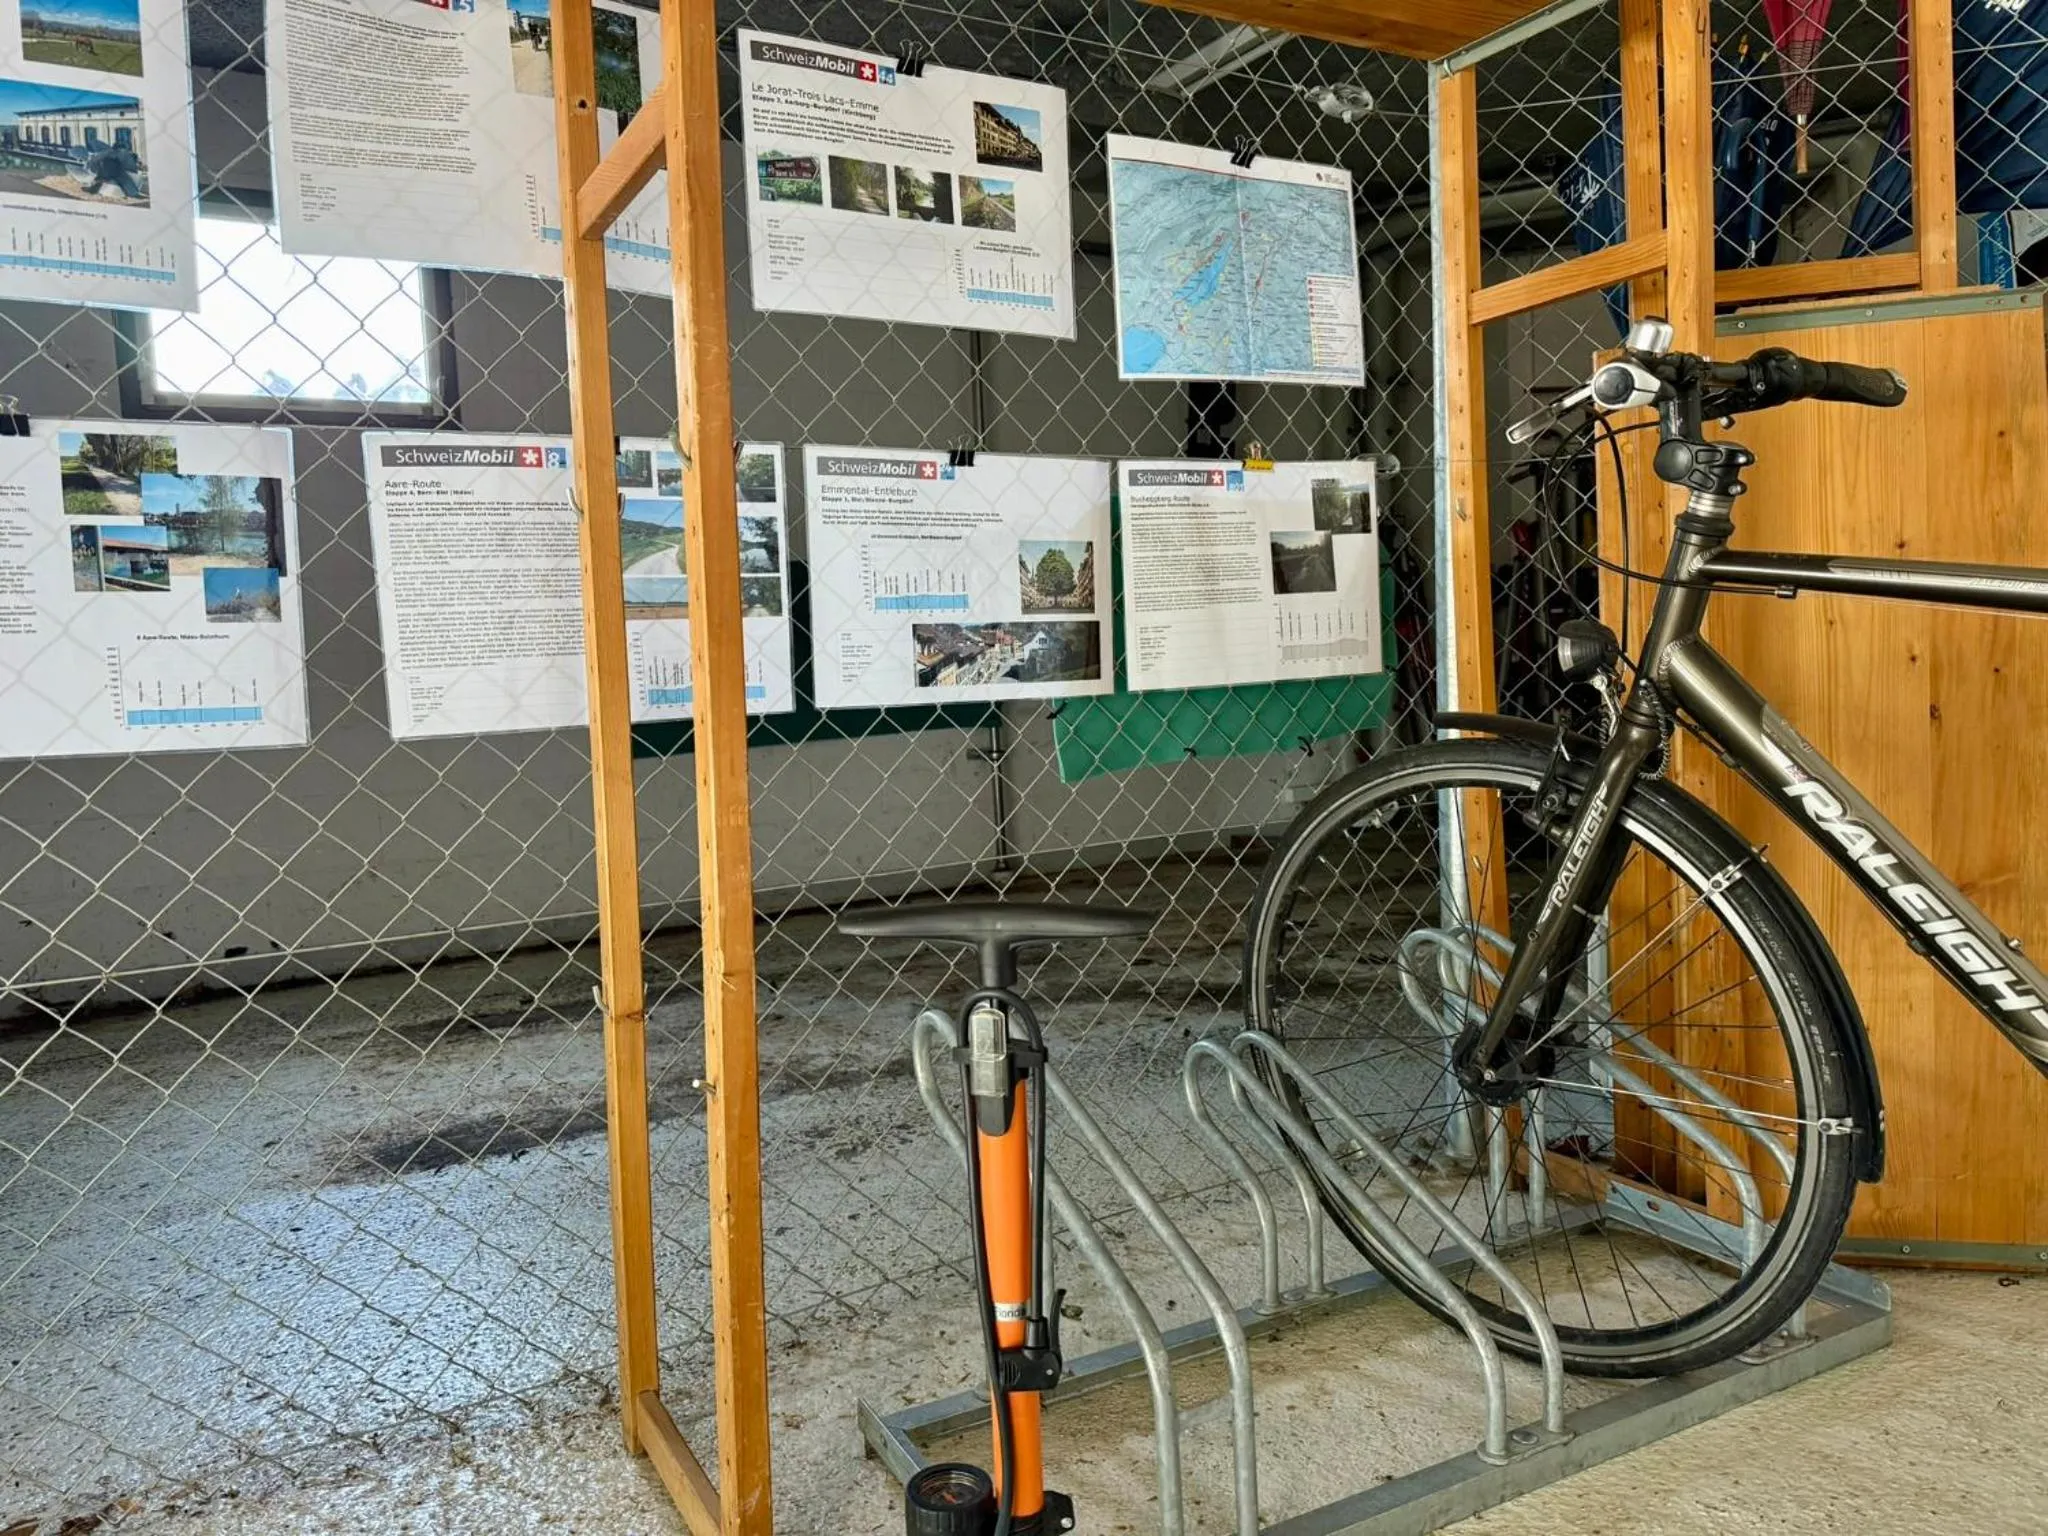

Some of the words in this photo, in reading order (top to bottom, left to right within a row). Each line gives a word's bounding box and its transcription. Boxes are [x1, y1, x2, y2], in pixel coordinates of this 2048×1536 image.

[762, 45, 855, 75] SchweizMobil
[751, 81, 765, 93] Le
[766, 83, 821, 100] Jorat-Trois
[823, 93, 880, 113] Lacs-Emme
[395, 449, 514, 464] SchweizMobil
[828, 460, 917, 476] SchweizMobil
[384, 480, 442, 489] Aare-Route
[1136, 472, 1207, 484] SchweizMobil
[821, 484, 918, 497] Emmental-Entlebuch
[1551, 797, 1608, 908] RALEIGH
[1782, 780, 2044, 1011] RALEIGH
